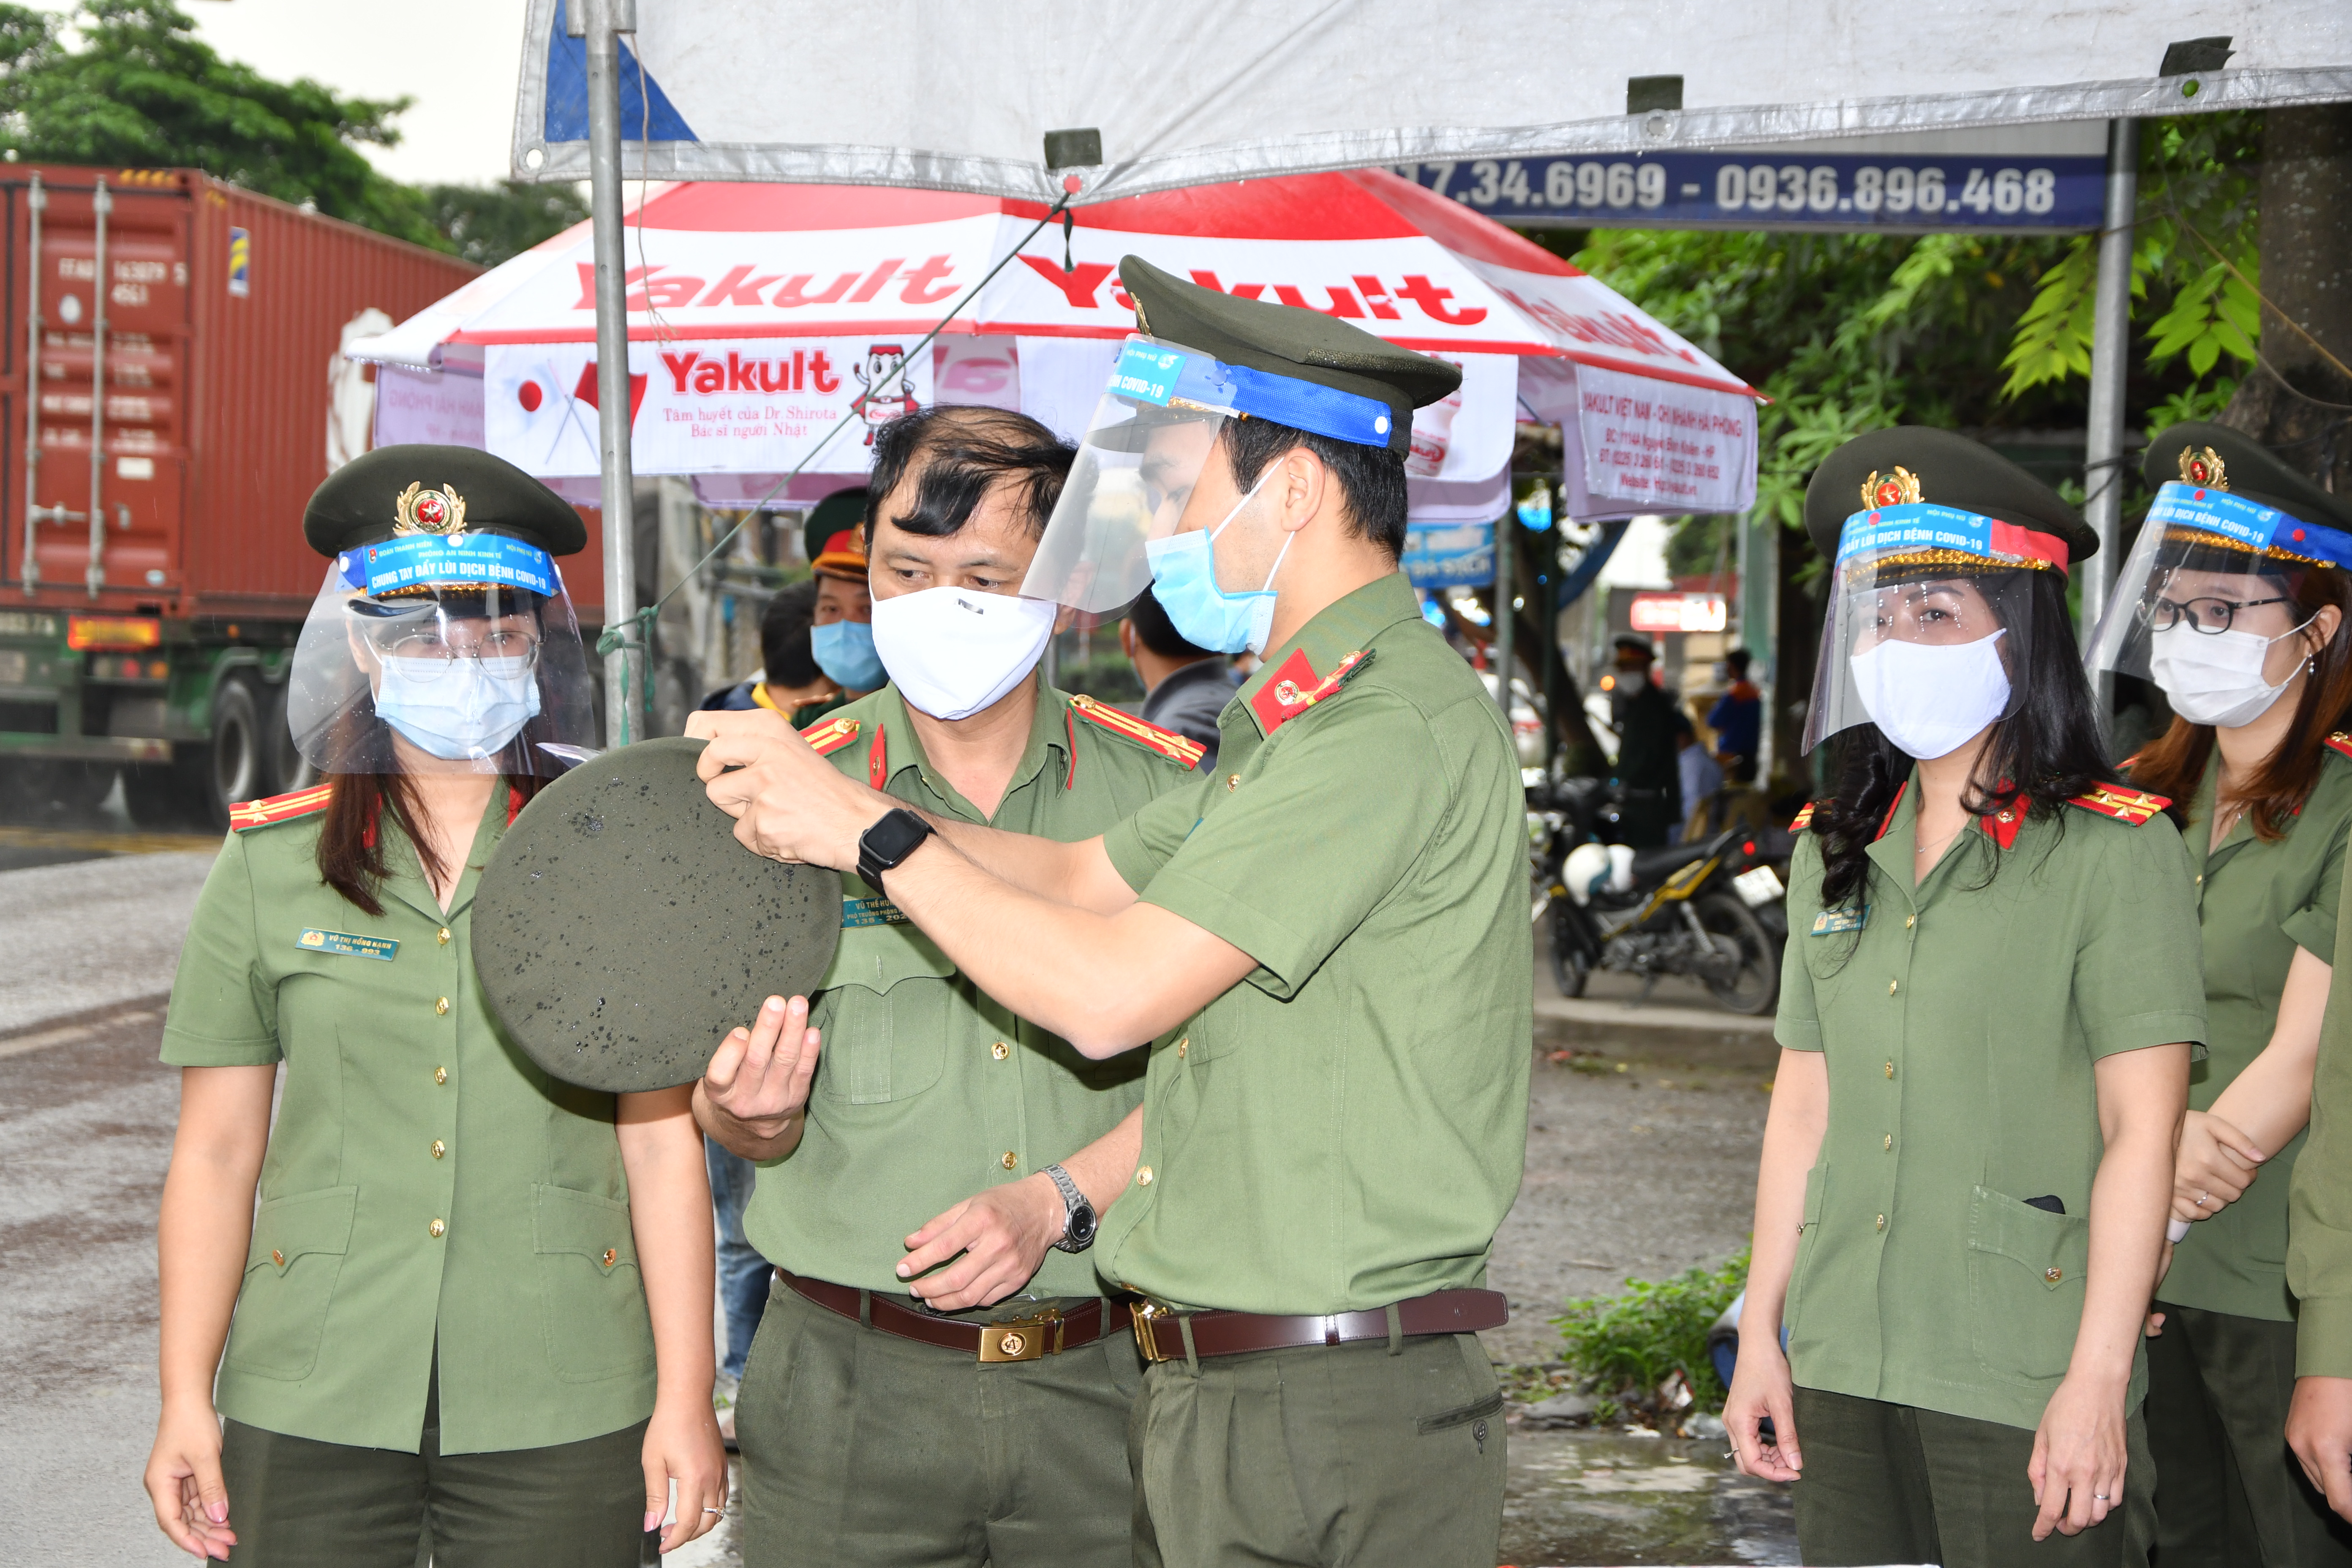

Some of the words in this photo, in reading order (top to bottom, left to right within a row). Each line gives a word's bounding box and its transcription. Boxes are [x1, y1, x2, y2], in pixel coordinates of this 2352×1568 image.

[1681, 183, 1700, 195] -
[1716, 163, 2056, 214] 0936.896.468
[573, 254, 963, 312] Yakult
[660, 349, 841, 394] Yakult
[1121, 376, 1164, 398] COVID-19
[663, 407, 692, 421] Tâm
[698, 406, 732, 422] huyết
[738, 406, 759, 421] của
[691, 423, 712, 437] Bác
[734, 423, 767, 439] người
[773, 422, 808, 437] Nhật
[2175, 508, 2196, 520] DỊCH
[2195, 512, 2222, 527] BỆNH
[2221, 519, 2265, 543] COVID-19
[395, 543, 415, 552] THANH
[1861, 533, 1876, 547] LÙI
[1878, 529, 1902, 545] DỊCH
[1903, 527, 1933, 542] BỆNH
[1936, 531, 1983, 550] COVID-19
[418, 549, 444, 558] PHÒNG
[495, 551, 503, 559] TẾ
[371, 571, 398, 589] CHUNG
[398, 566, 413, 581] TAY
[415, 559, 436, 577] ĐẨY
[438, 559, 457, 574] LÙI
[459, 562, 486, 577] DỊCH
[488, 563, 514, 580] BỆNH
[515, 569, 547, 589] COVID-19
[866, 898, 879, 909] THẾ
[340, 936, 351, 945] THỊ
[352, 937, 372, 947] HỒNG
[372, 941, 392, 950] HẠNH
[361, 947, 380, 956] 993
